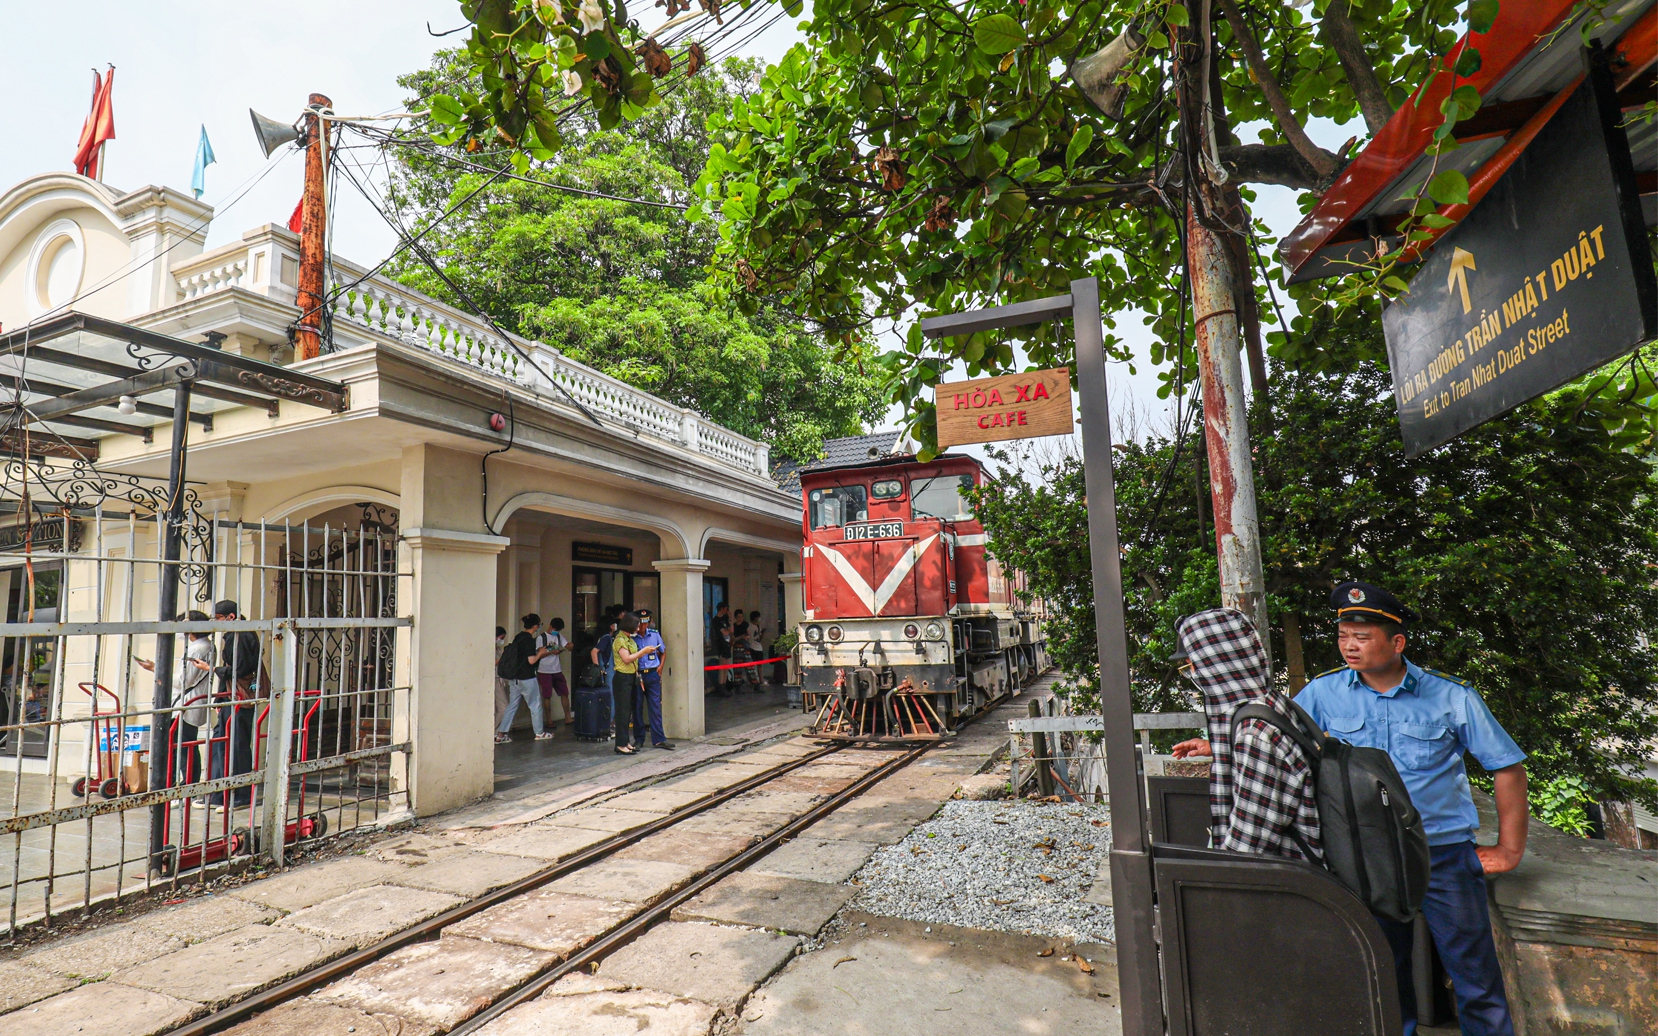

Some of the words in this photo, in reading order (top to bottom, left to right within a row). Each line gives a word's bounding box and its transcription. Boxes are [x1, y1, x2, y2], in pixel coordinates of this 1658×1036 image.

[1400, 373, 1415, 405] LỐI
[1415, 369, 1429, 395] RA
[1428, 339, 1466, 384] ĐƯỜNG
[1465, 309, 1502, 355] TRẦN
[1502, 270, 1548, 329] NHẬT
[1551, 224, 1605, 292] DUẬT
[1423, 395, 1439, 419] Exit
[1440, 390, 1450, 409] to
[1450, 377, 1472, 402] Tran
[1472, 357, 1497, 390] Nhat
[1497, 337, 1527, 375] Duat
[1527, 307, 1570, 355] Street
[954, 387, 1003, 410] HỎA
[1015, 382, 1049, 403] XA
[977, 410, 1027, 429] CAFE
[16, 522, 64, 544] STION
